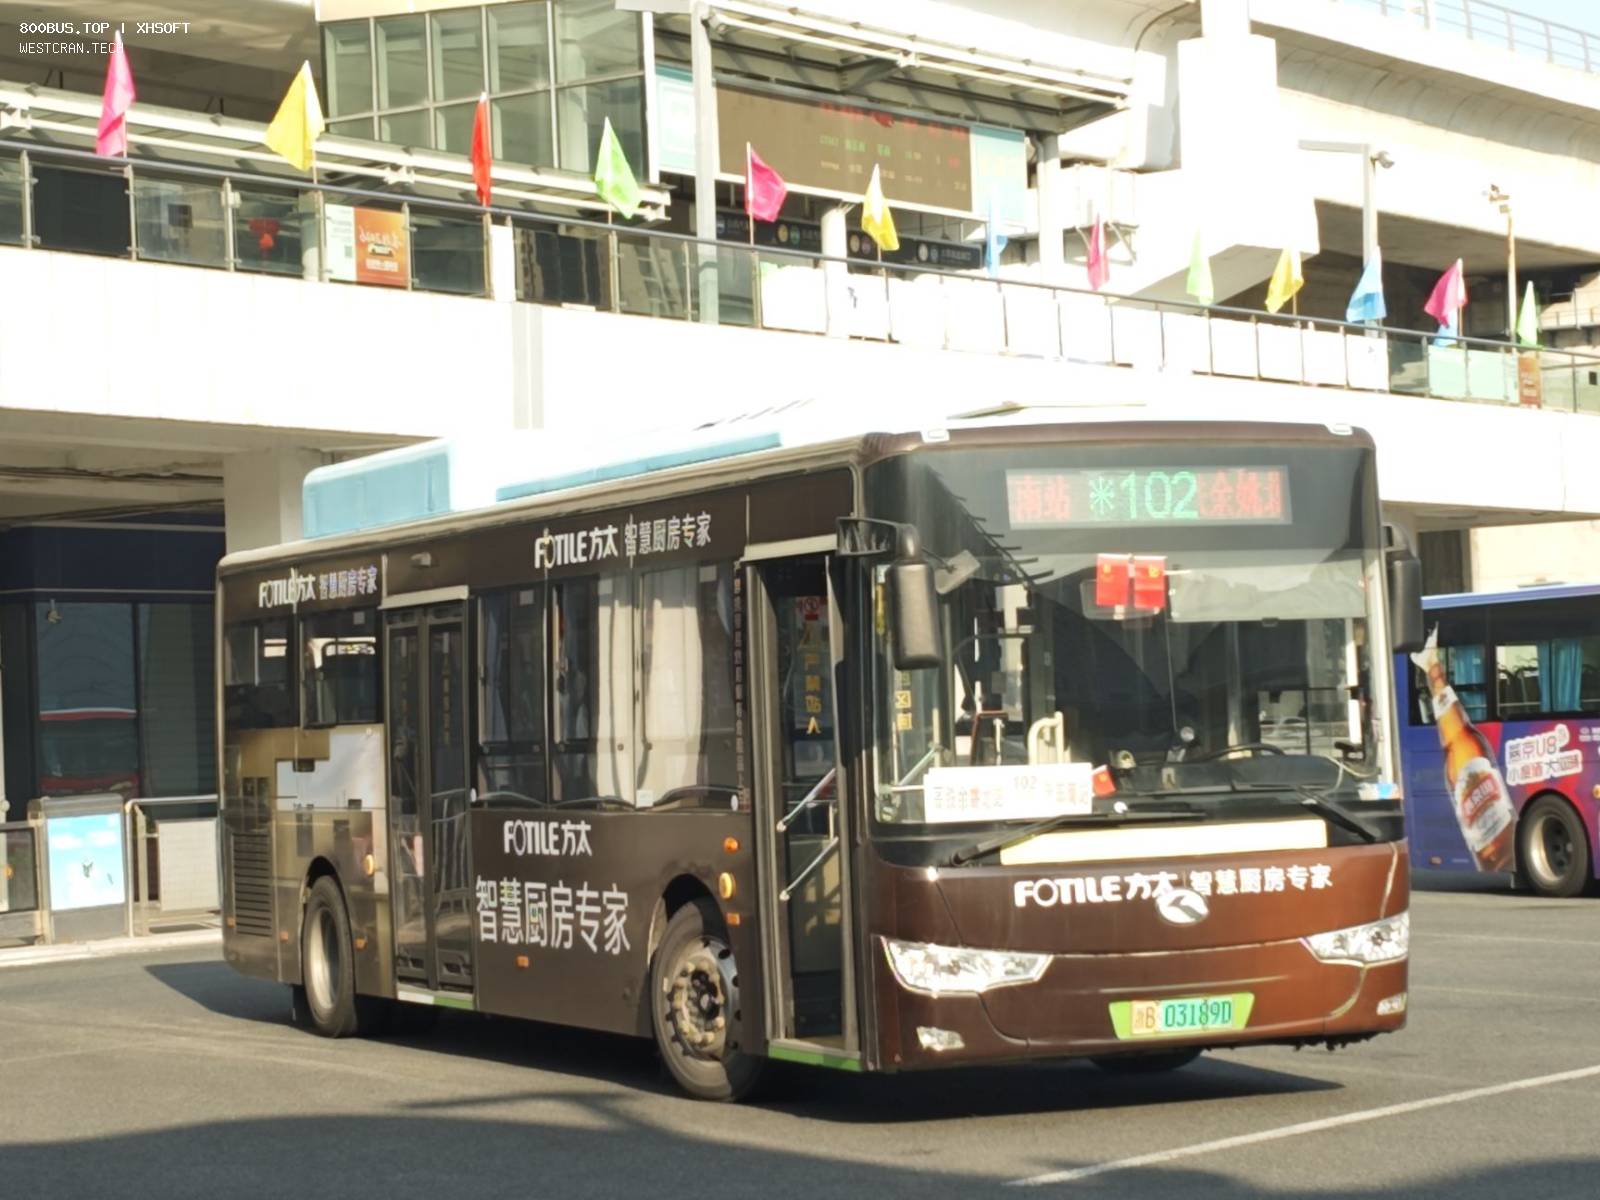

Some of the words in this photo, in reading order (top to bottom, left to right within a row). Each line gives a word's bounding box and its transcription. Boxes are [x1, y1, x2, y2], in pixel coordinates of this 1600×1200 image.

[624, 512, 712, 558] 智慧厨房专家
[1013, 876, 1123, 908] FOTILE
[1189, 863, 1333, 896] 智慧厨房专家
[475, 874, 632, 955] 智慧厨房专家
